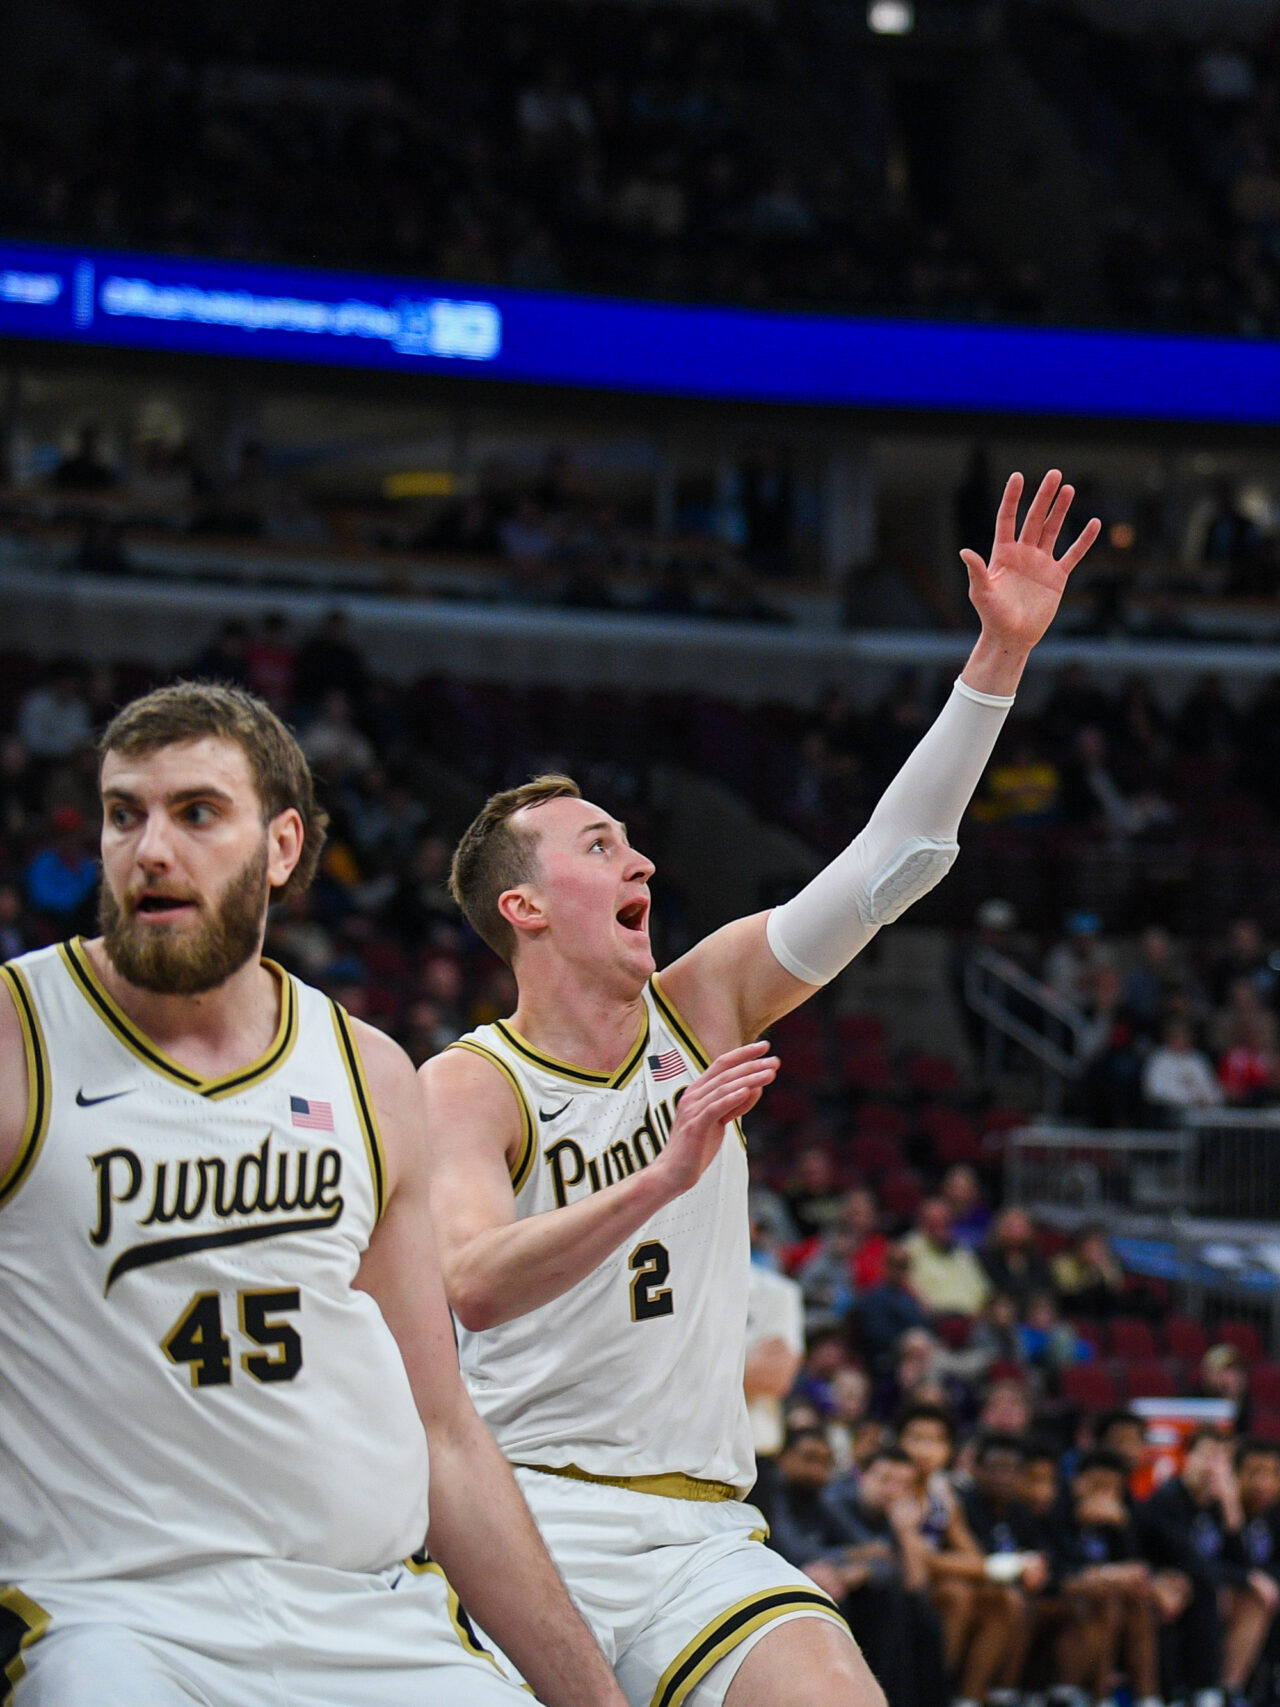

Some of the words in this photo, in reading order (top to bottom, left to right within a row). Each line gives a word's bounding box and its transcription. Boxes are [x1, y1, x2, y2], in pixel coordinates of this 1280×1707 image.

[88, 1129, 345, 1249] Purdue
[544, 1085, 688, 1208] Purdu
[628, 1239, 675, 1322] 2
[160, 1286, 303, 1388] 45
